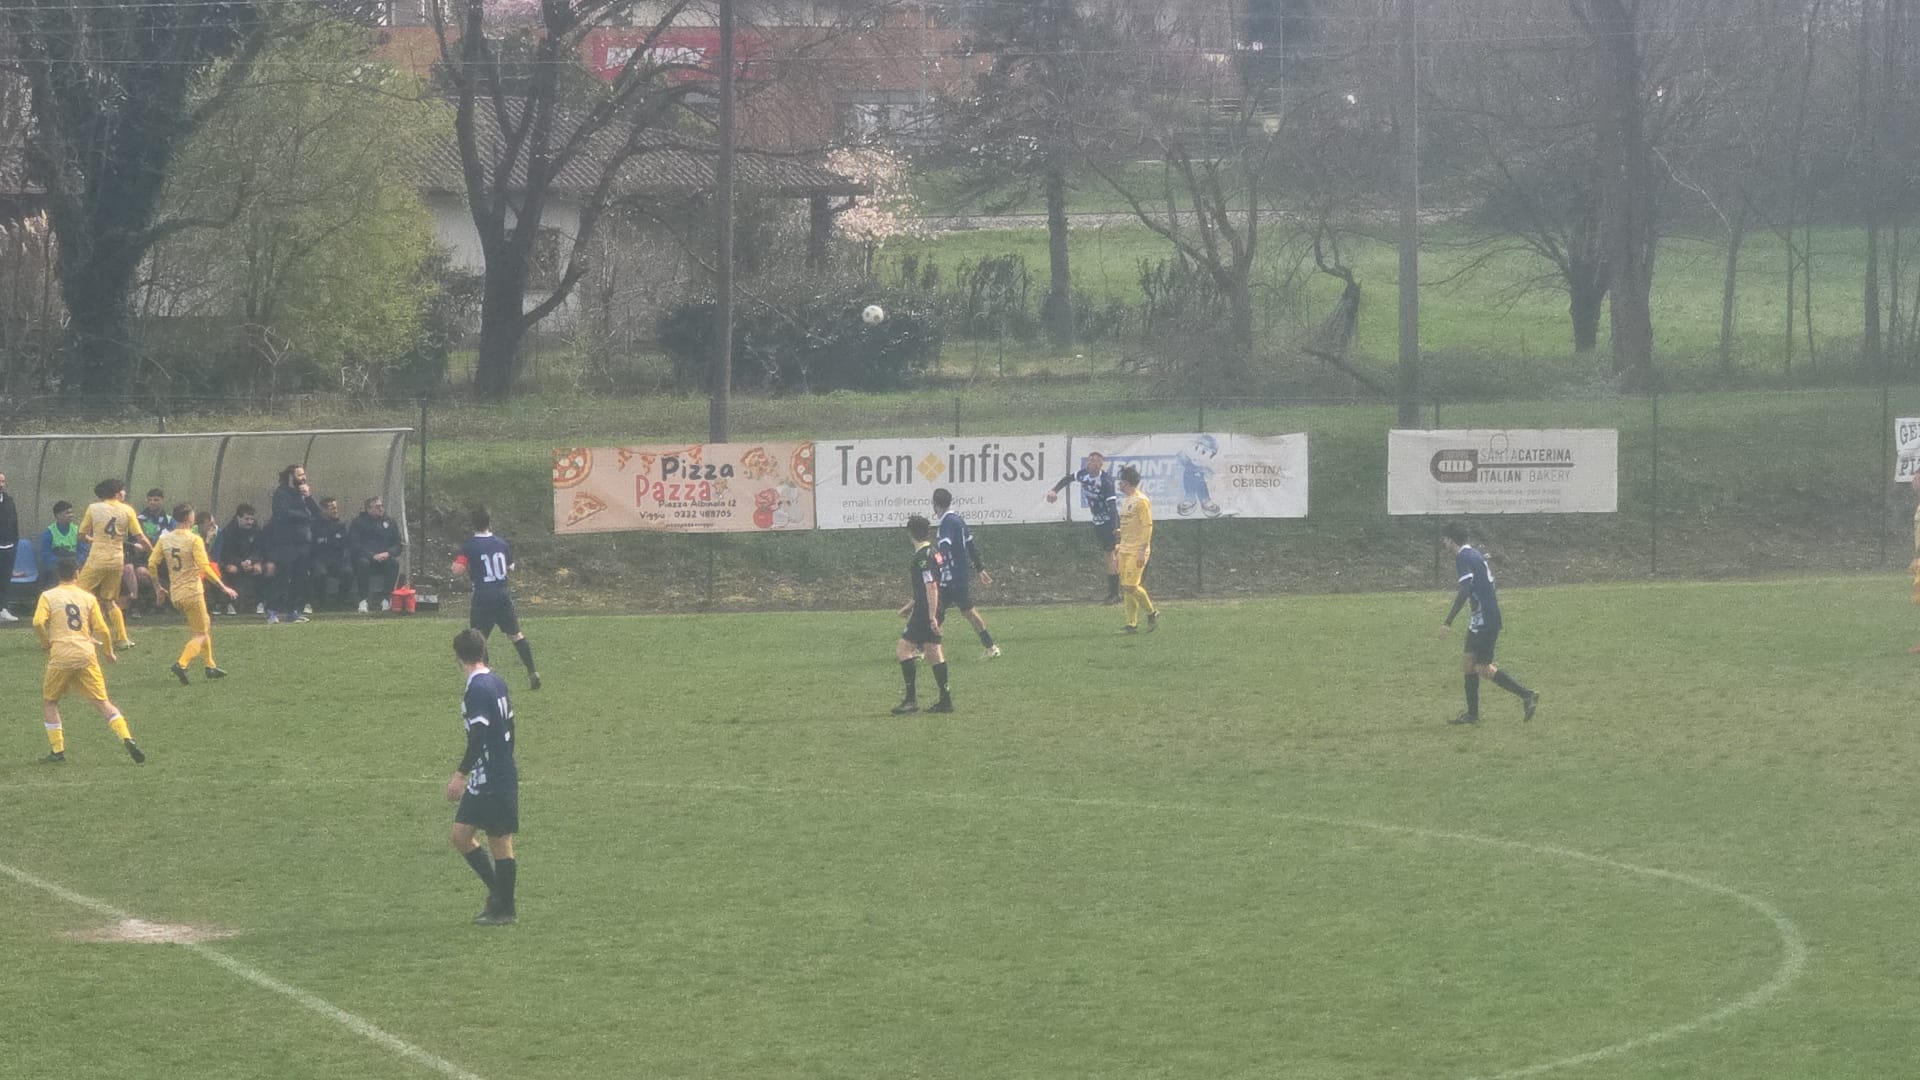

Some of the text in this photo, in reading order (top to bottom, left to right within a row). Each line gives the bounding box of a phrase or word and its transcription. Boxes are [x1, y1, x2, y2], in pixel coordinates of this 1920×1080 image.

[1900, 424, 1920, 445] GE
[661, 456, 735, 481] Pizza
[948, 442, 1045, 484] infissi
[1230, 464, 1282, 474] OFFICINA
[1233, 478, 1281, 488] CERESIO
[1480, 470, 1521, 483] ITALIAN
[1529, 470, 1570, 482] BAKERY
[636, 474, 712, 507] Pazza
[658, 500, 688, 508] Piazza
[674, 510, 697, 518] 0332
[104, 516, 117, 540] 4
[861, 513, 885, 523] 0332
[170, 548, 182, 571] 5
[481, 552, 507, 583] 10
[65, 603, 82, 631] 8
